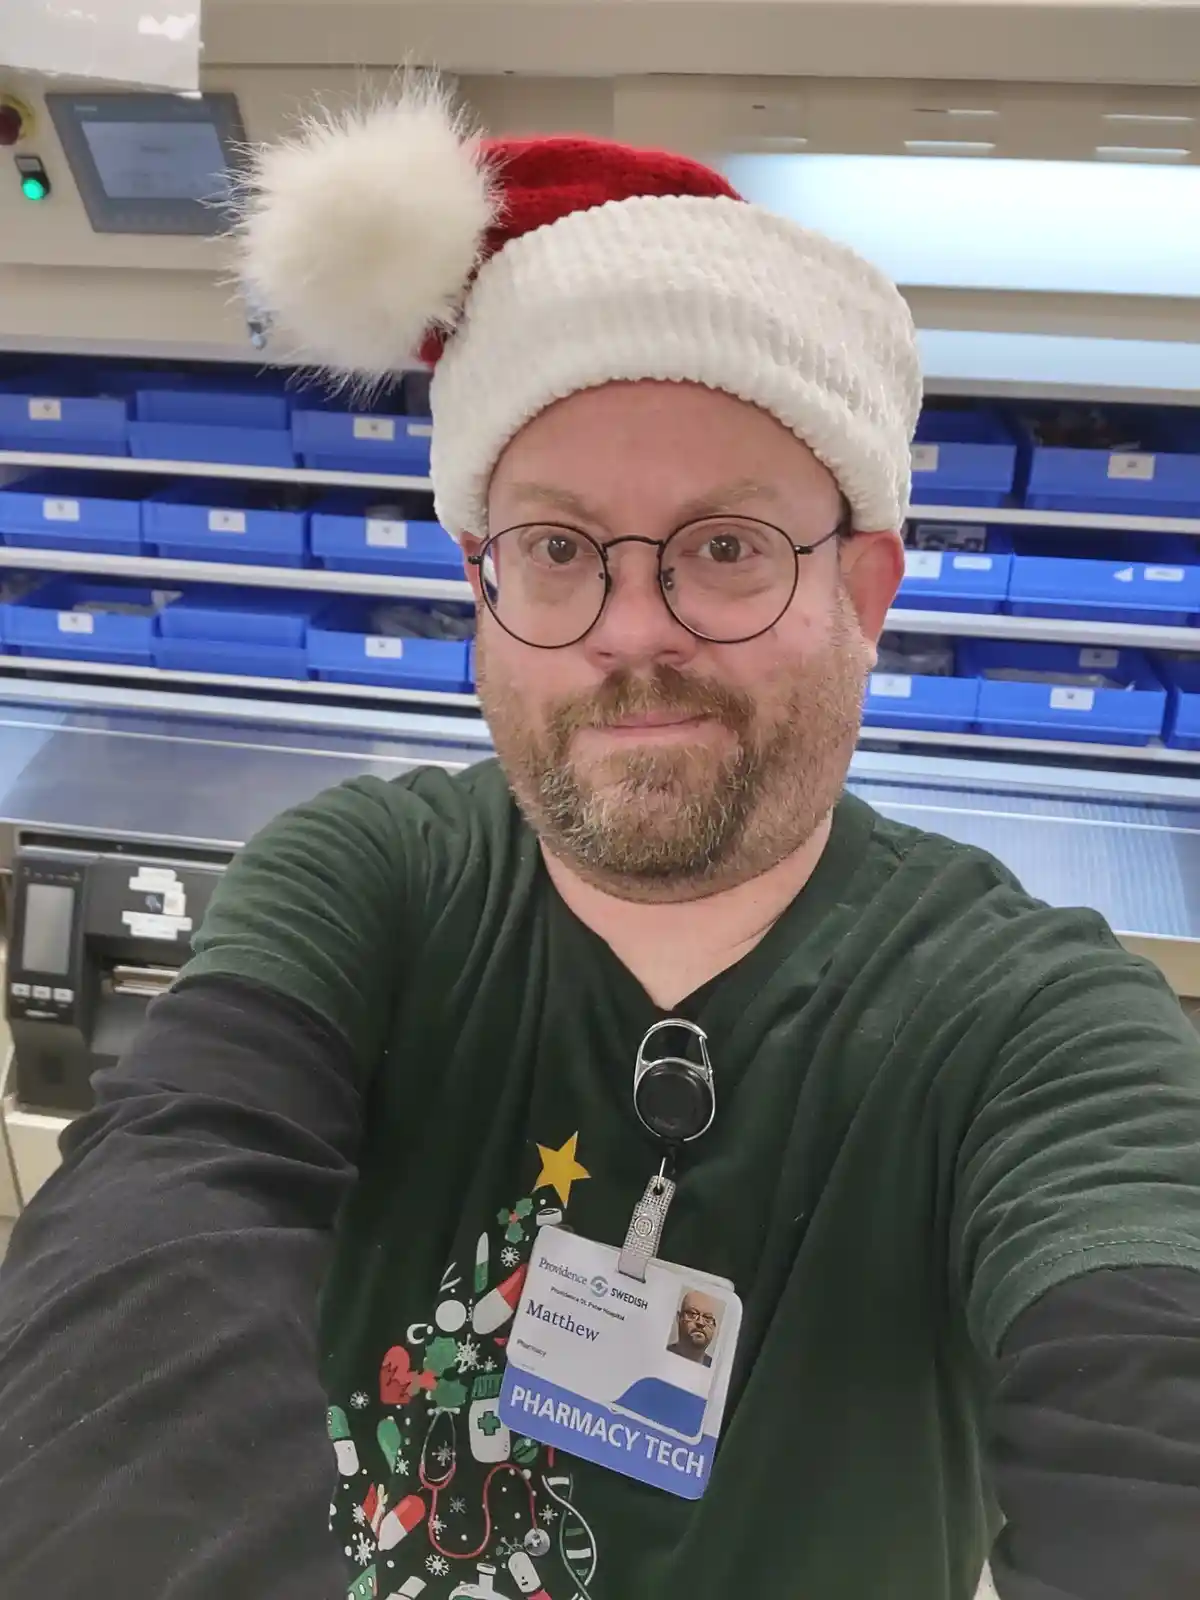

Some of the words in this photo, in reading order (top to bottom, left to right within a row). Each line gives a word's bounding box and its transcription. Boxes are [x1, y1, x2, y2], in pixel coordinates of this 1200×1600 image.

[538, 1257, 588, 1286] Providence
[610, 1287, 649, 1310] SWEDISH
[526, 1298, 600, 1342] Matthew
[510, 1384, 641, 1451] PHARMACY
[644, 1434, 705, 1478] TECH
